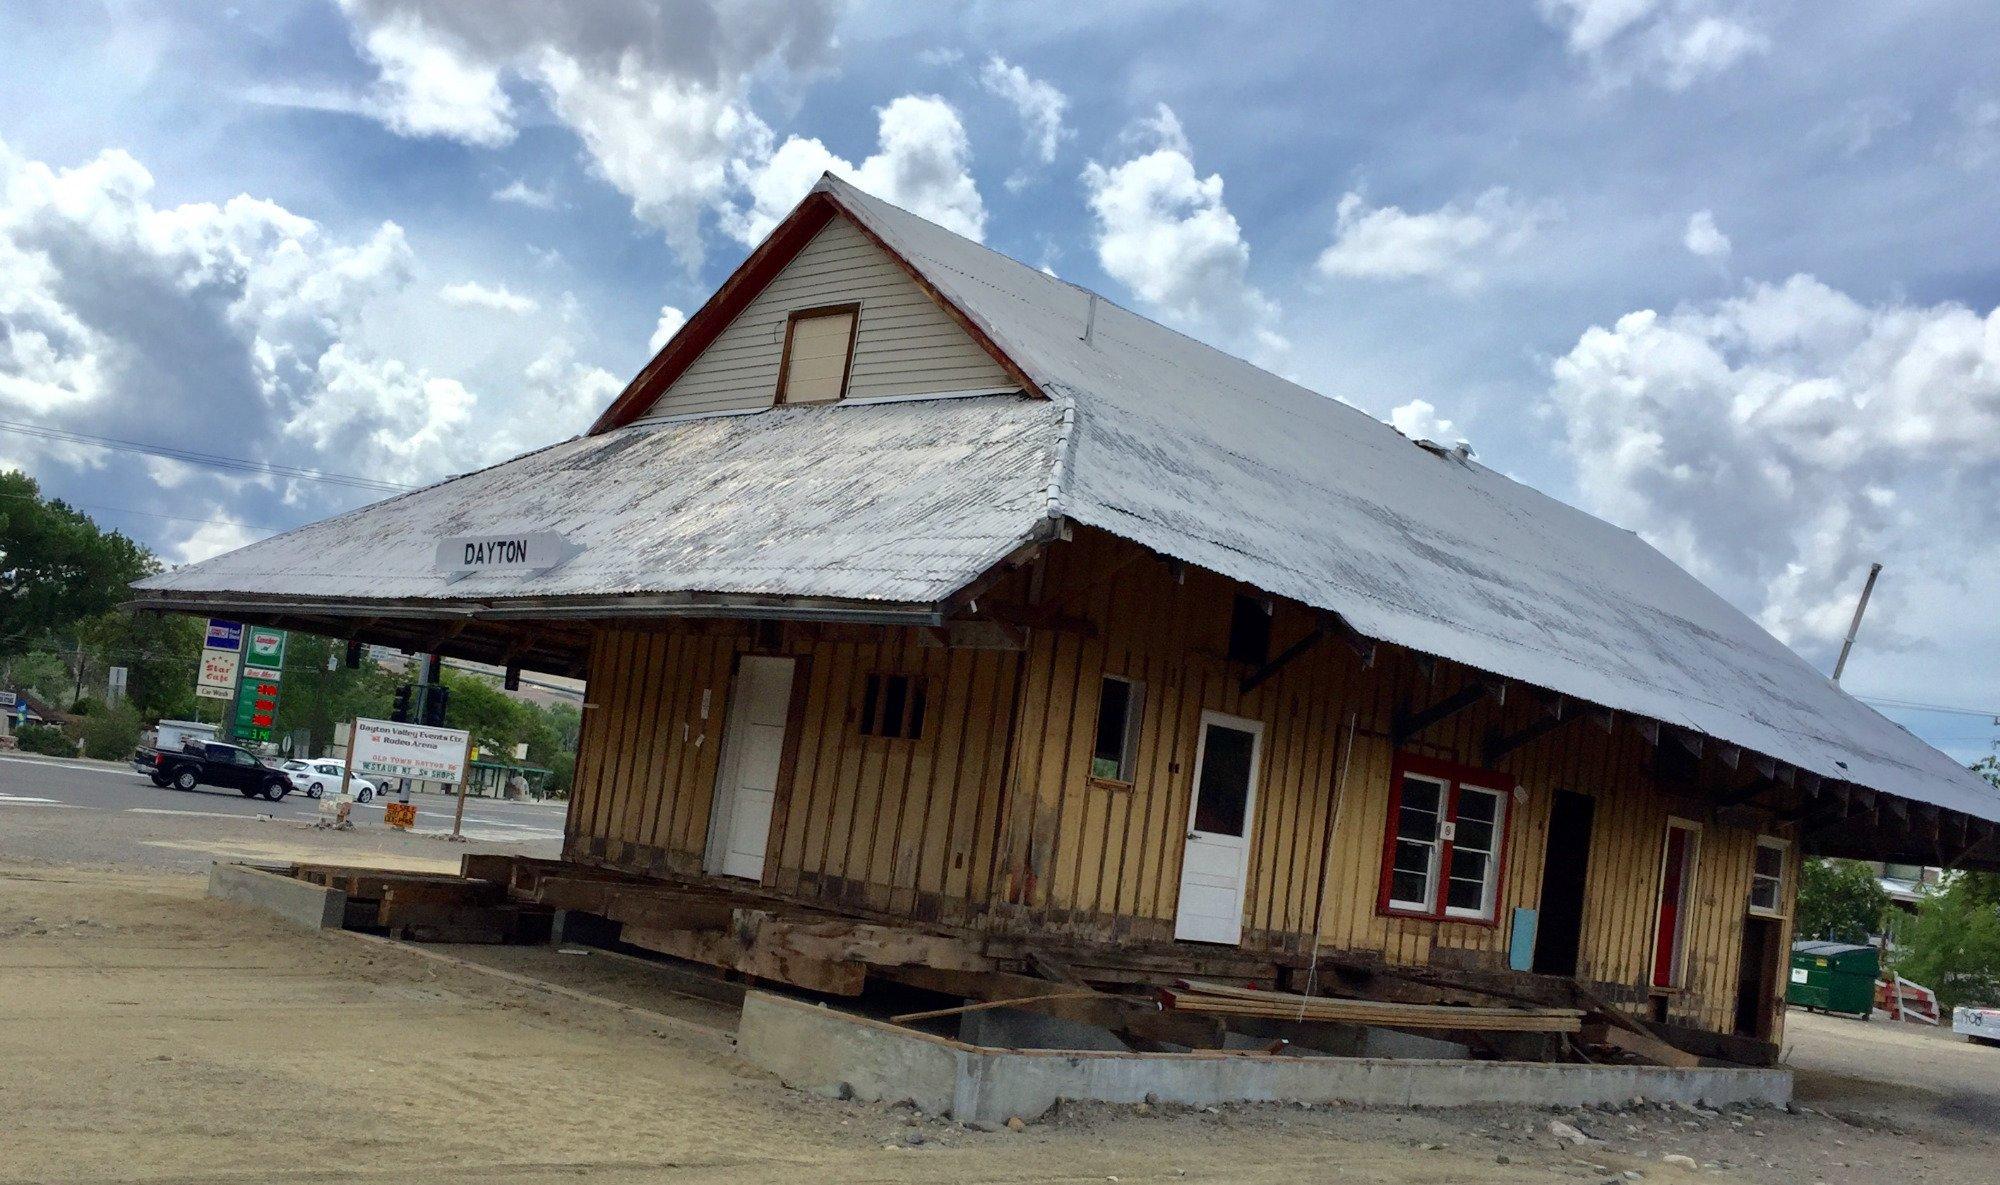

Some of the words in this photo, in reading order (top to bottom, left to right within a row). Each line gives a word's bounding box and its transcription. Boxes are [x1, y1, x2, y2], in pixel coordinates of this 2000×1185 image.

[464, 539, 527, 565] DAYTON
[205, 664, 230, 673] Star
[206, 673, 229, 682] Cafe
[360, 724, 391, 733] Dayton
[392, 726, 418, 738] Valley
[420, 731, 448, 741] Events
[383, 736, 411, 746] Rodeo
[411, 740, 438, 749] Arena
[372, 755, 388, 763] OLD
[431, 770, 456, 780] SHOPS
